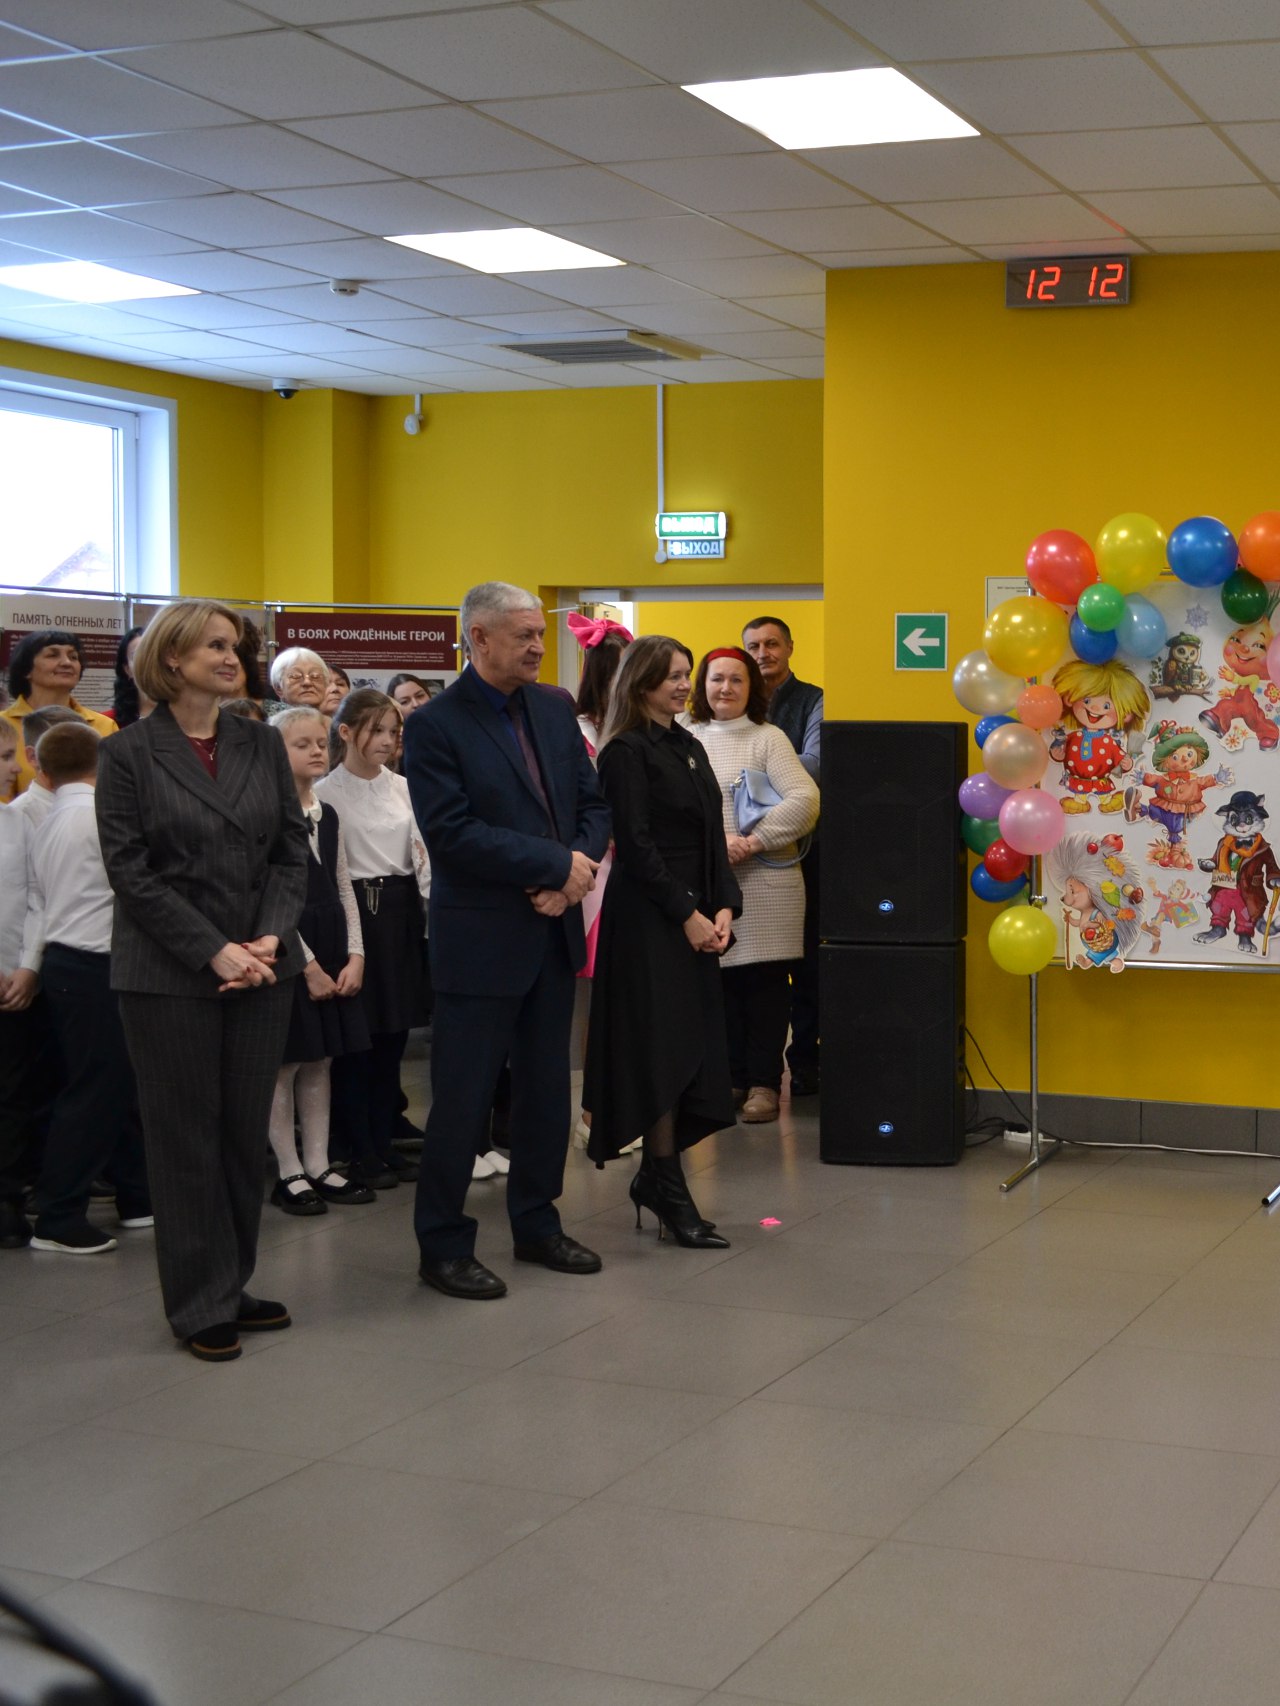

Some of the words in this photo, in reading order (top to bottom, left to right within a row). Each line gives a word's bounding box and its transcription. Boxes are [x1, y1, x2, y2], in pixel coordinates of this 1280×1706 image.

[1026, 266, 1061, 300] 12
[1088, 263, 1124, 297] 12
[672, 541, 720, 555] ВЫХОД
[12, 613, 52, 626] ПАМЯТЬ
[54, 615, 104, 629] ОГНЕННЫХ
[106, 618, 122, 629] ЛЕТ
[287, 628, 296, 639] В
[298, 628, 330, 640] БОЯХ
[333, 627, 407, 642] РОЖДЁННЫЕ
[409, 630, 445, 642] ГЕРОИ
